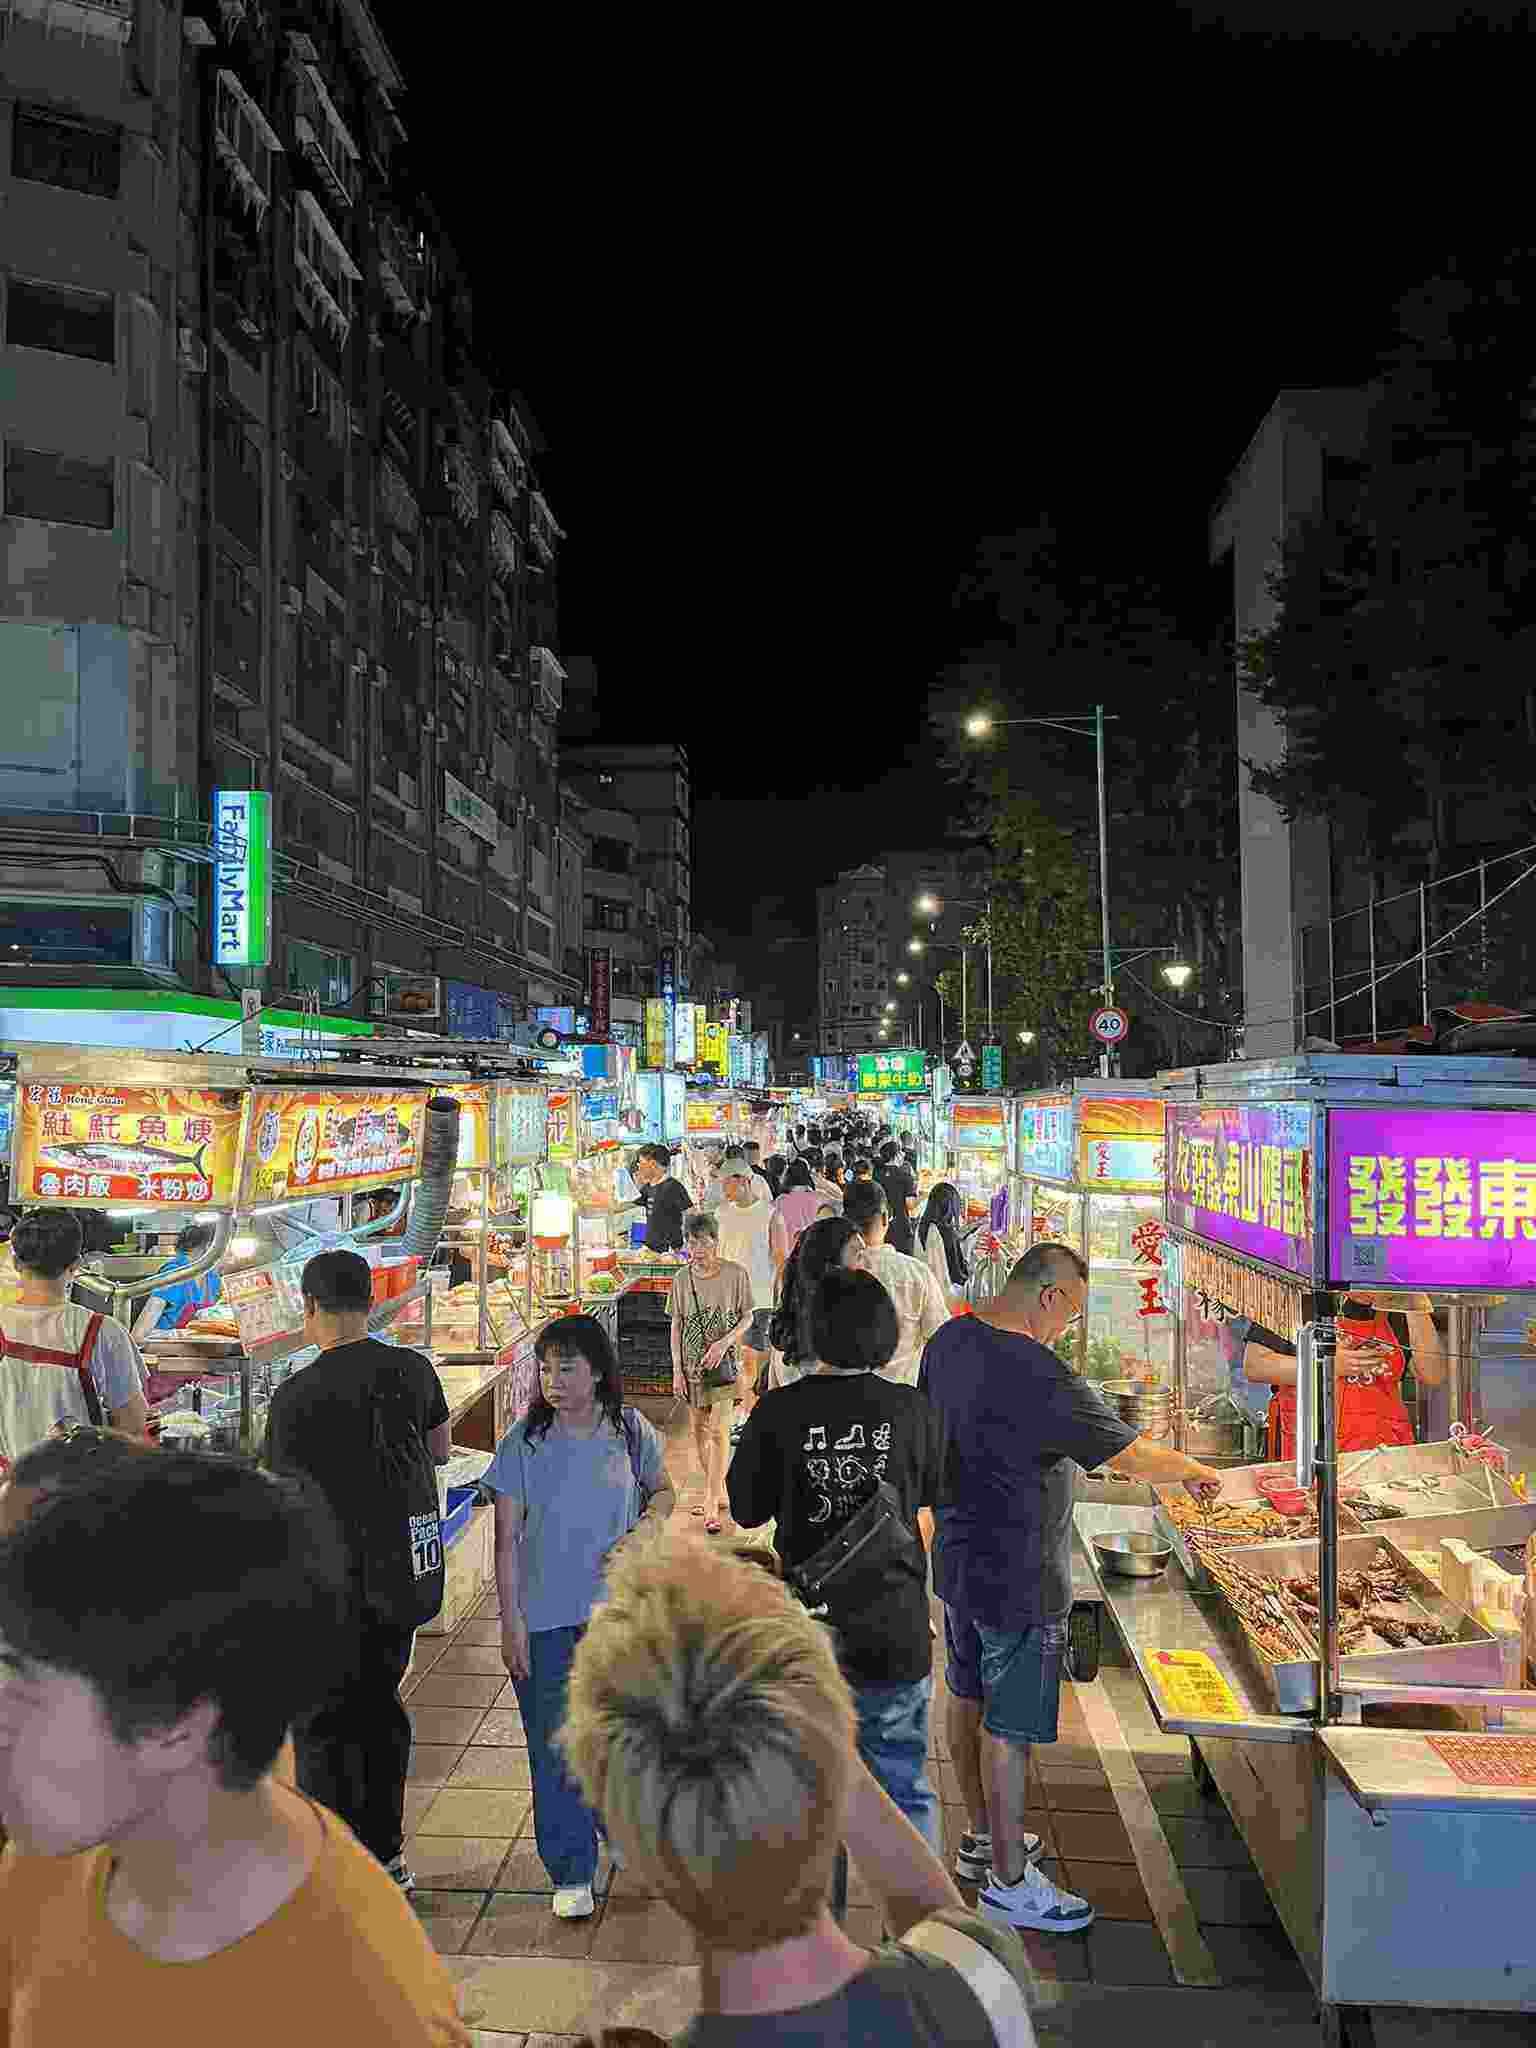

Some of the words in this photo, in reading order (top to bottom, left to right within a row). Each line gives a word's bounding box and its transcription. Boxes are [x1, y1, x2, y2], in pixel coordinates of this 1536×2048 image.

[219, 803, 247, 951] FamilyMart
[1098, 1018, 1121, 1031] 40
[1348, 1154, 1536, 1240] 發發東
